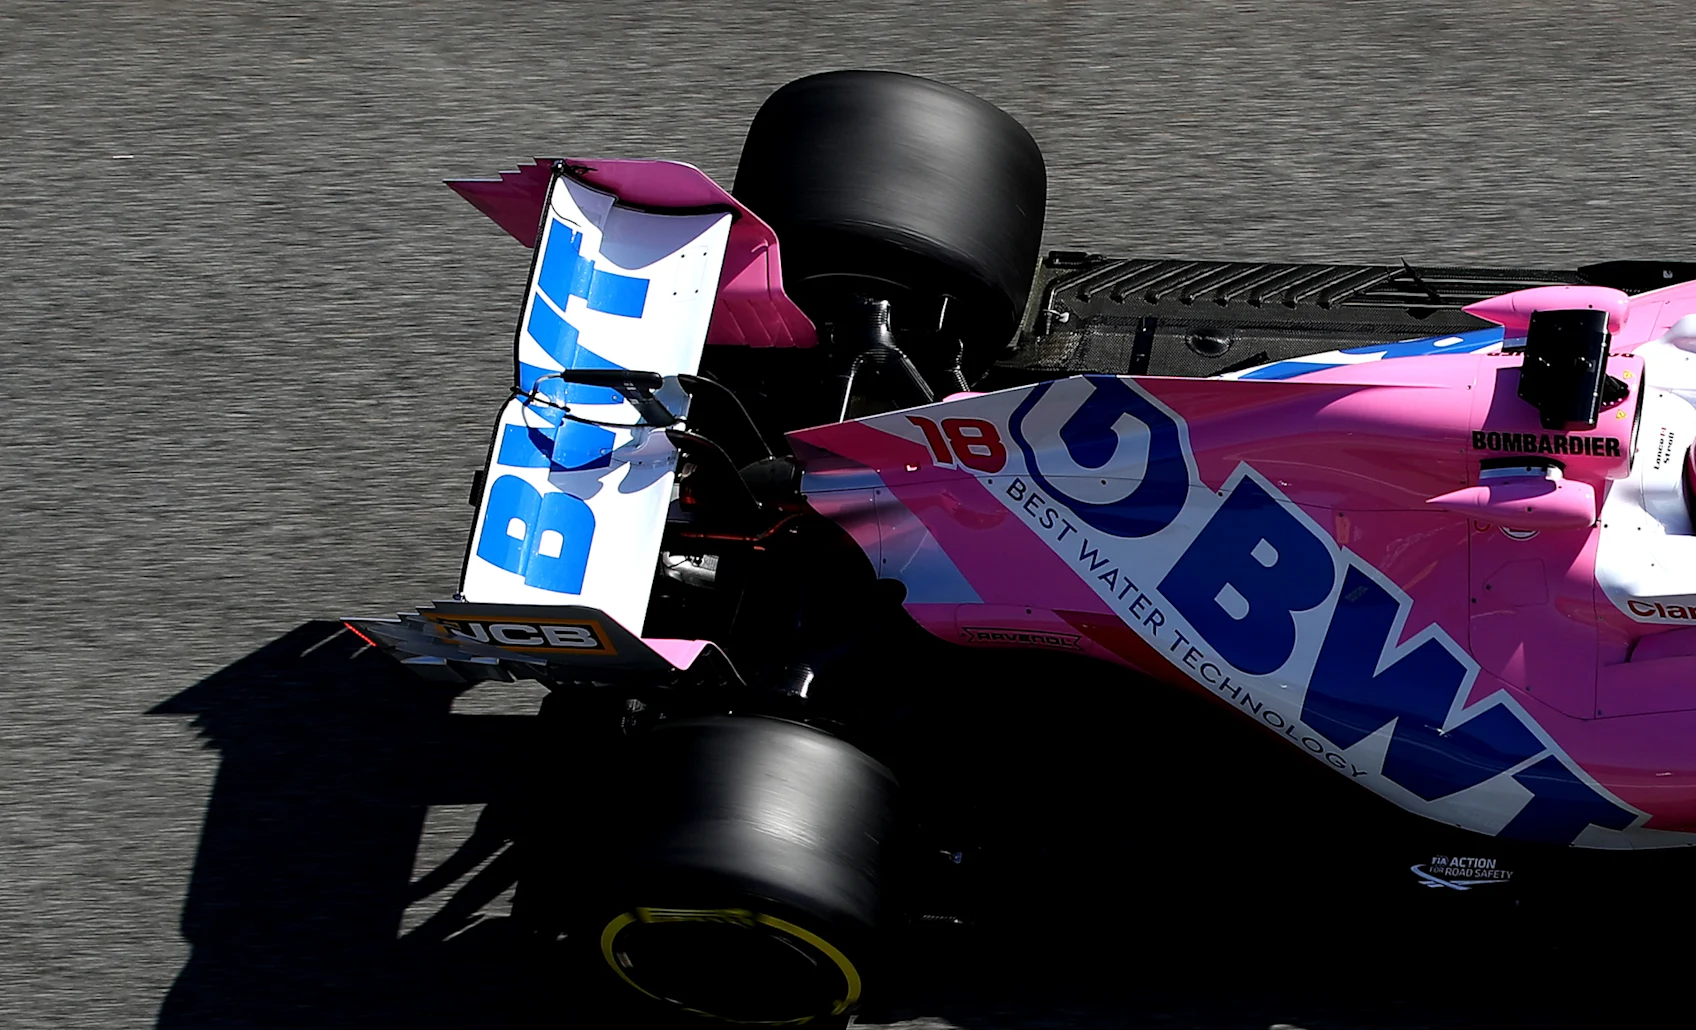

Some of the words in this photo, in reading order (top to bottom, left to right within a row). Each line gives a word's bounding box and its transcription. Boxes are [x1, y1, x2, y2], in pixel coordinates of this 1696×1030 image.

[476, 218, 650, 595] BWT
[906, 415, 1007, 473] 18
[1472, 430, 1621, 457] BOMBARDIER
[1653, 438, 1664, 470] Lance
[1663, 431, 1675, 464] Stroll
[451, 622, 598, 648] JCB
[1006, 477, 1078, 542] BEST
[1077, 539, 1167, 636] WATER
[1169, 629, 1368, 778] TECHNOLOGY
[1157, 474, 1640, 846] BWT
[1444, 867, 1474, 878] ROAD
[1474, 868, 1514, 879] SAFETY
[1449, 857, 1497, 869] ACTION
